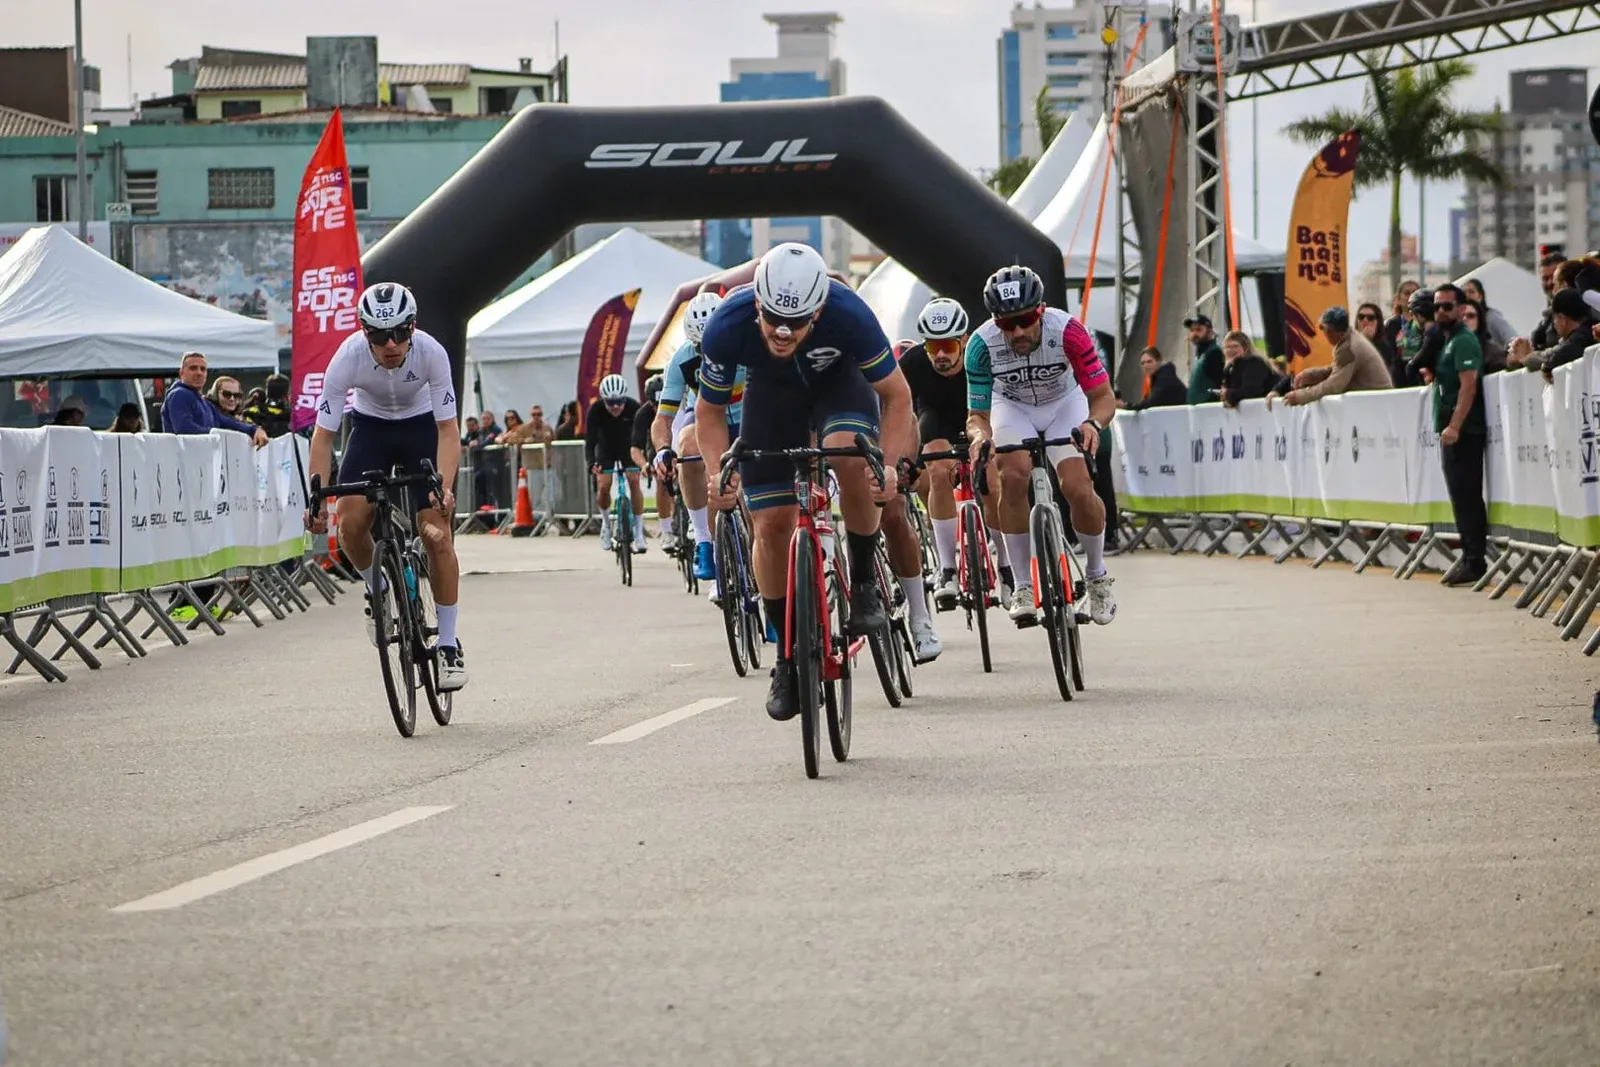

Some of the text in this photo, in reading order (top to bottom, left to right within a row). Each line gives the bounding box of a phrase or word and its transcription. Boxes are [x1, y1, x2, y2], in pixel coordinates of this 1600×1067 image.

[584, 137, 838, 168] SOUL
[312, 205, 346, 232] TE
[302, 265, 355, 291] ES nsc
[297, 287, 355, 313] POR
[775, 293, 800, 309] 288
[1003, 287, 1015, 299] 84
[315, 306, 358, 333] TE
[376, 307, 394, 319] 262
[931, 315, 948, 325] 299
